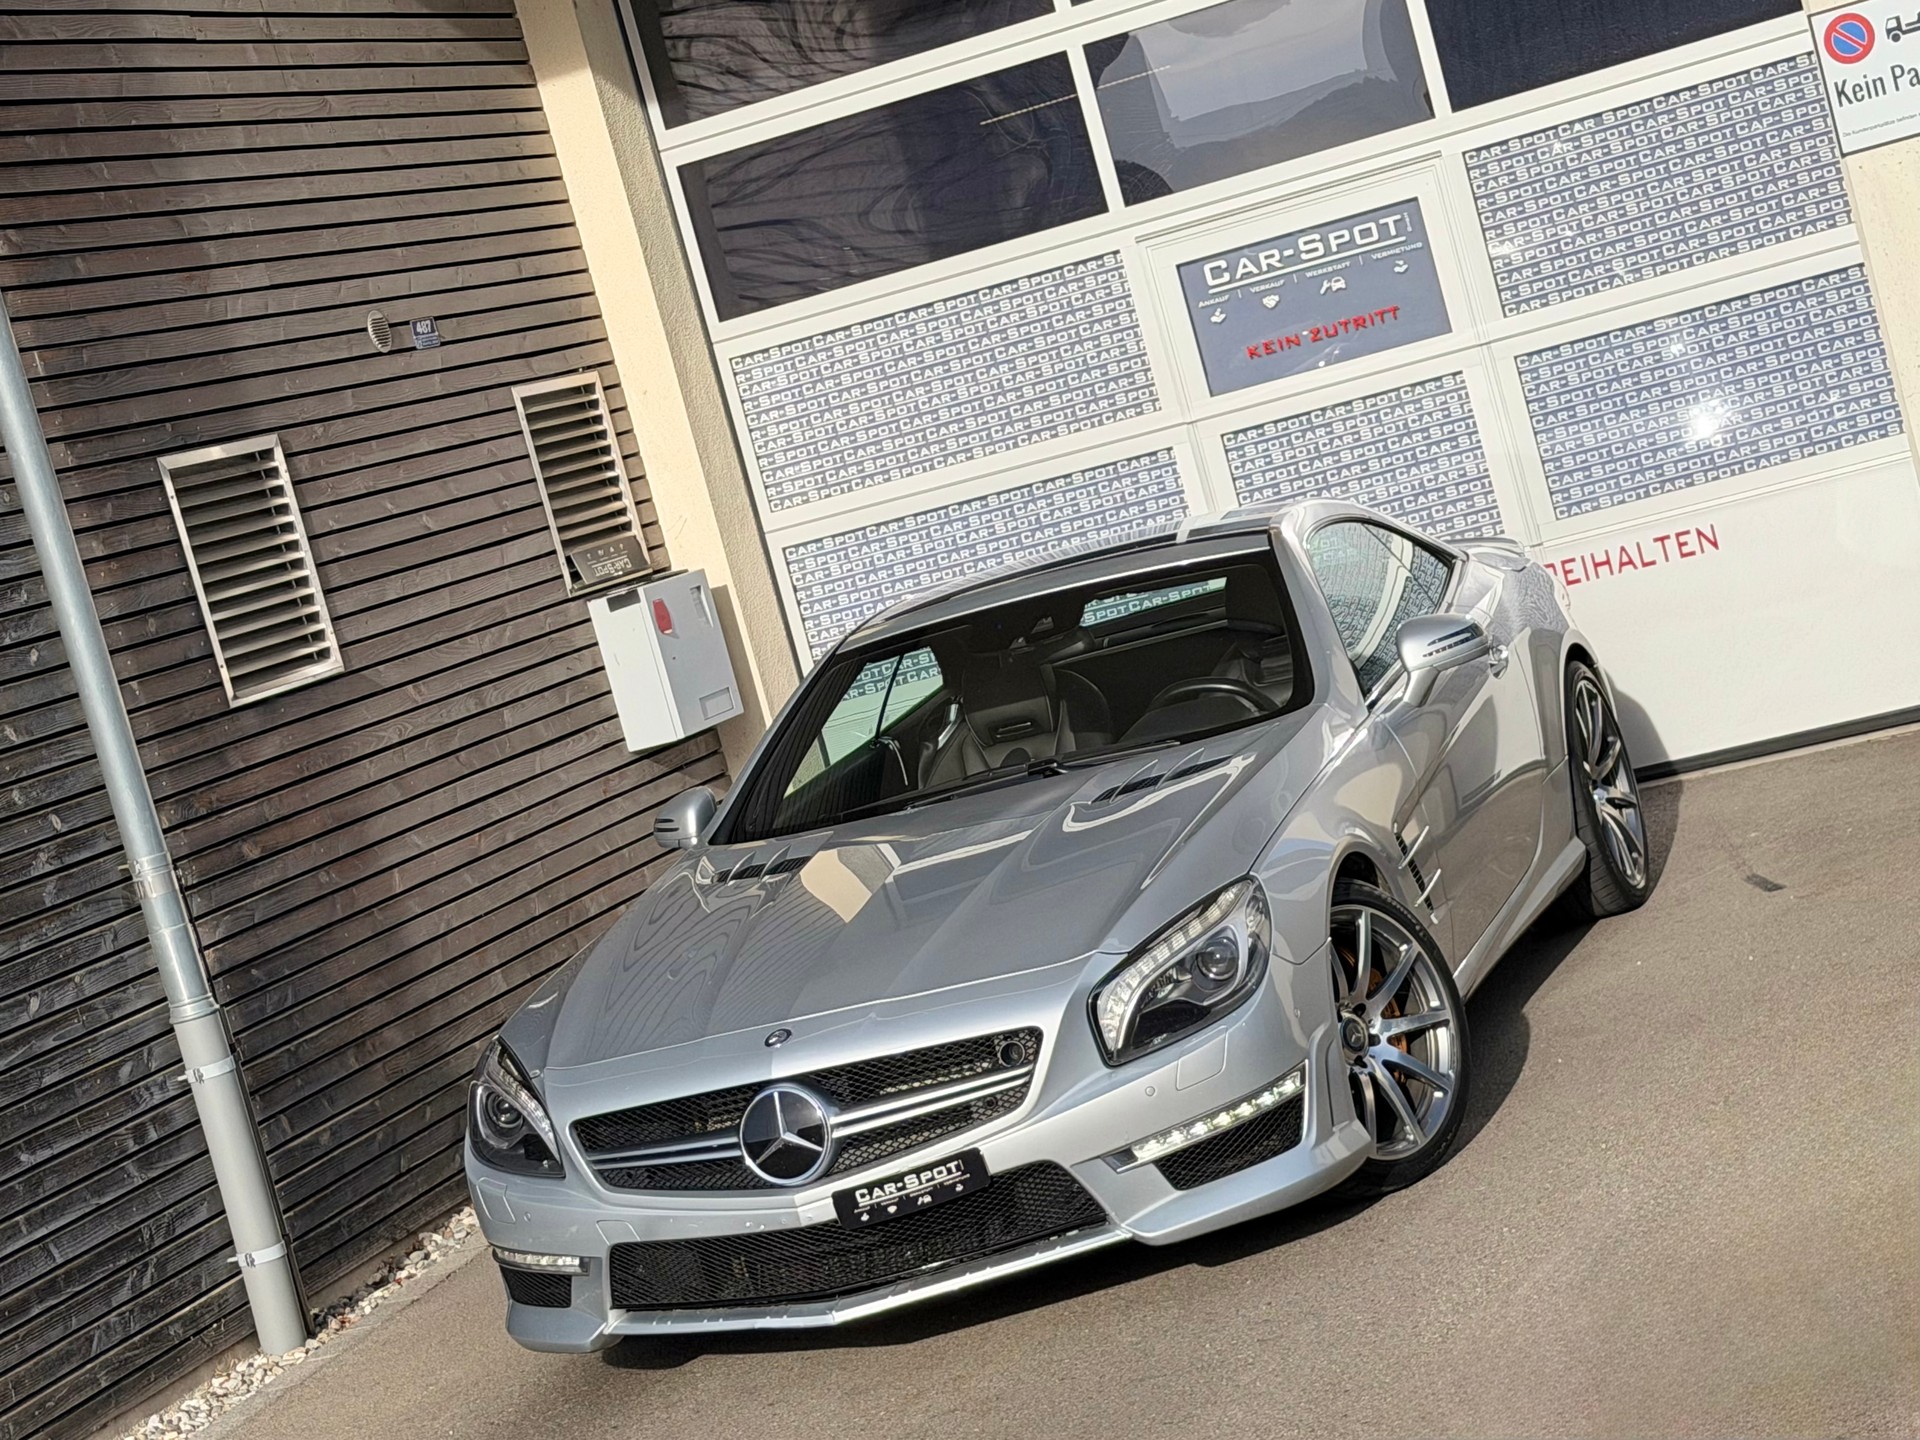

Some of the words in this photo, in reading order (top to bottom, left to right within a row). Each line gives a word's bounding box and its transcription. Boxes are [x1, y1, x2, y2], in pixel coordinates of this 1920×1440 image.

[1834, 74, 1886, 108] Kein
[1203, 214, 1402, 286] CAR-SPOT
[416, 320, 432, 334] 487
[1246, 334, 1302, 360] KEIN
[1310, 306, 1400, 343] ZUTRITT
[855, 1161, 958, 1202] CAR-SPOT
